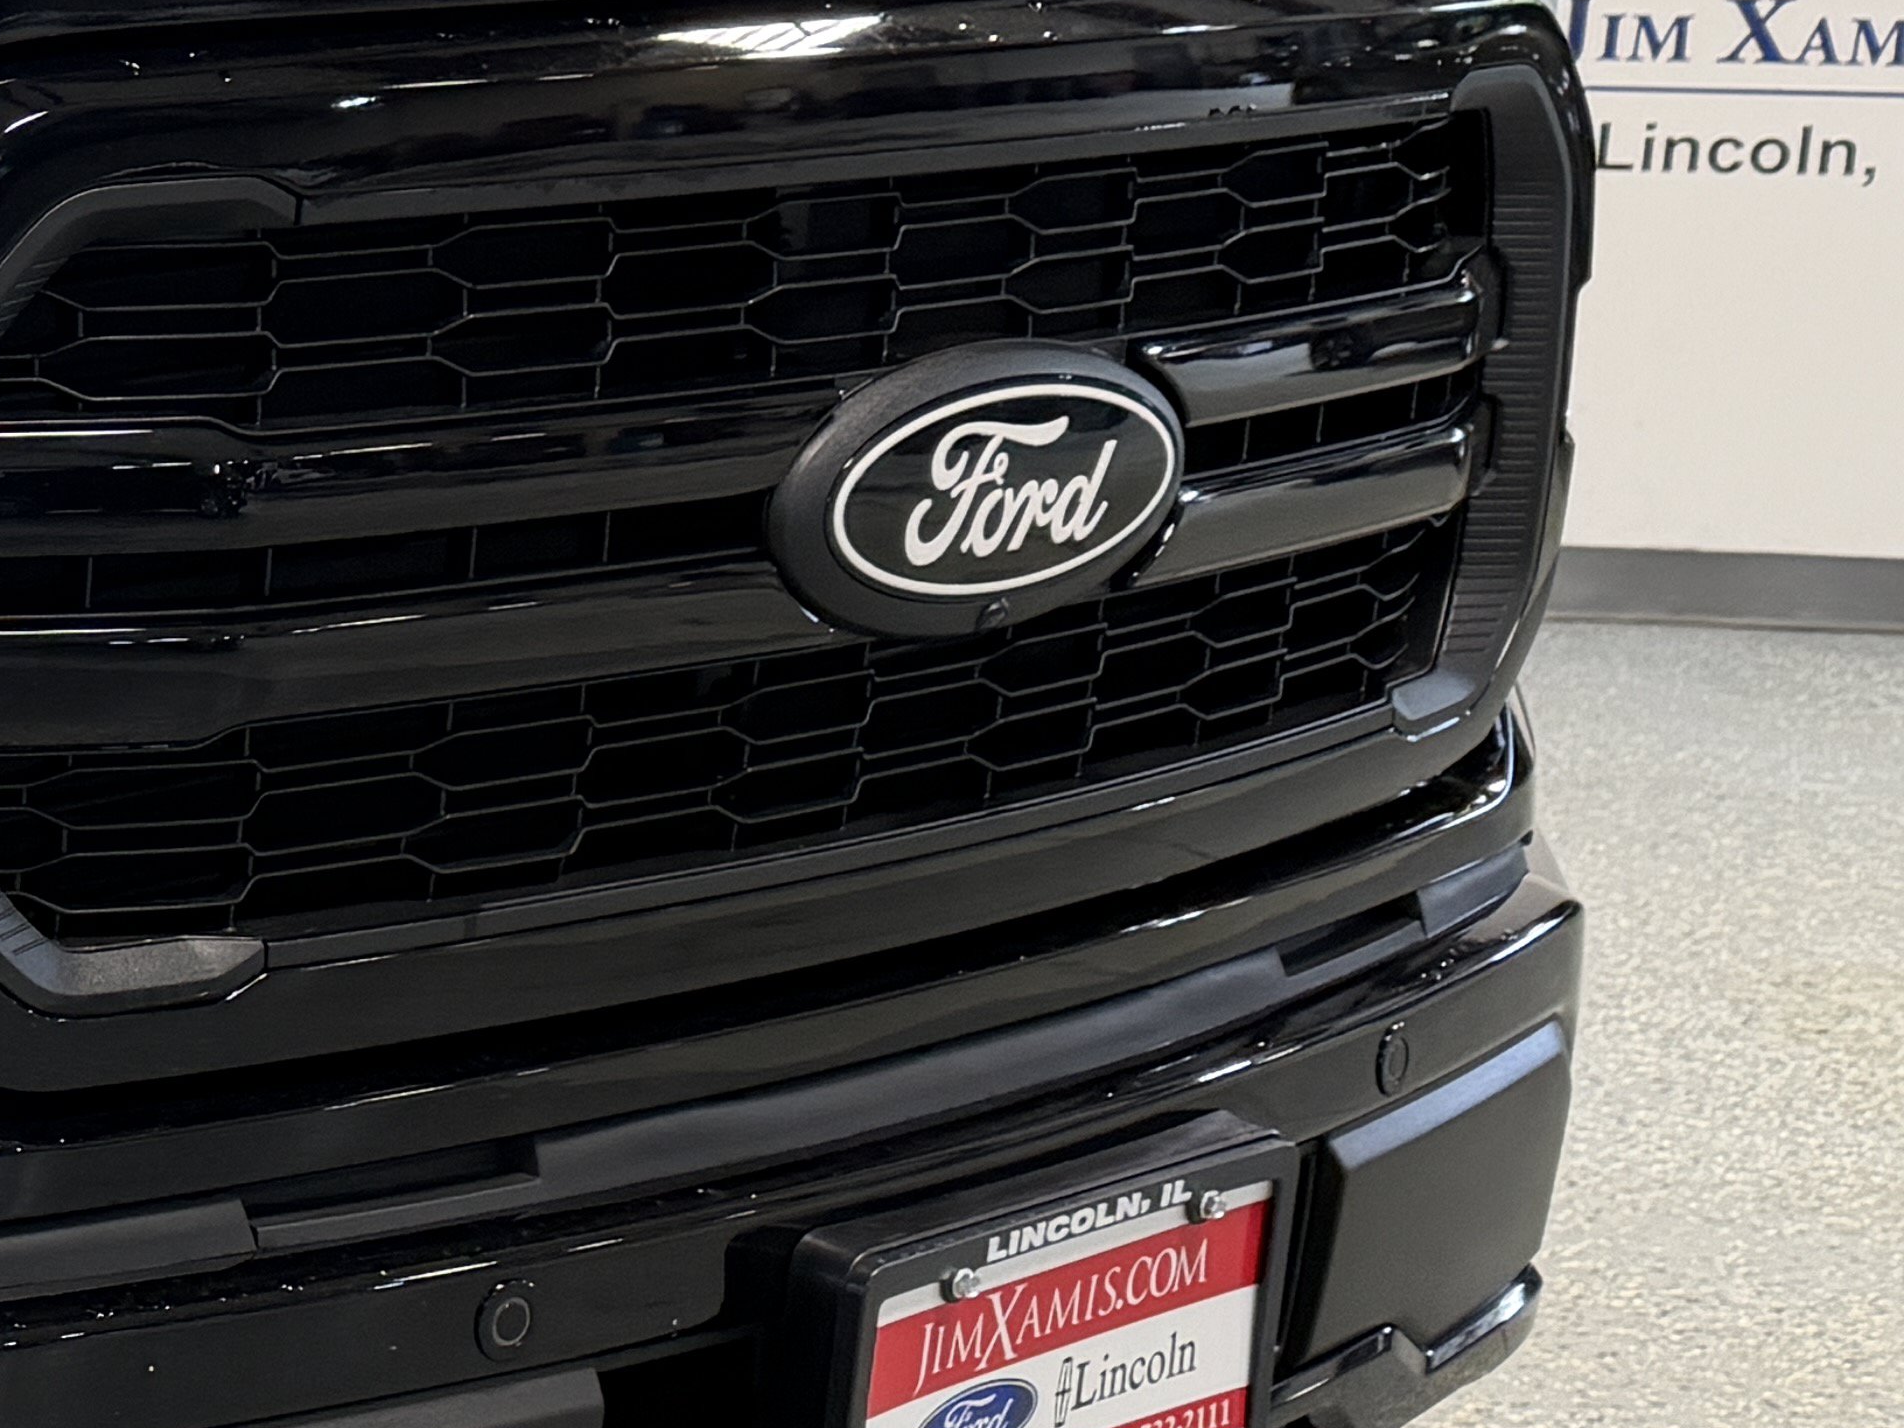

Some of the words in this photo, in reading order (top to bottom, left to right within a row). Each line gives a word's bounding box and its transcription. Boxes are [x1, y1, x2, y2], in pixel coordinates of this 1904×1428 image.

[1596, 121, 1878, 188] Lincoln,
[903, 414, 1118, 567] Ford
[985, 1188, 1151, 1265] LINCOLN,
[1159, 1178, 1193, 1209] IL
[1072, 1332, 1198, 1411] Lincoln
